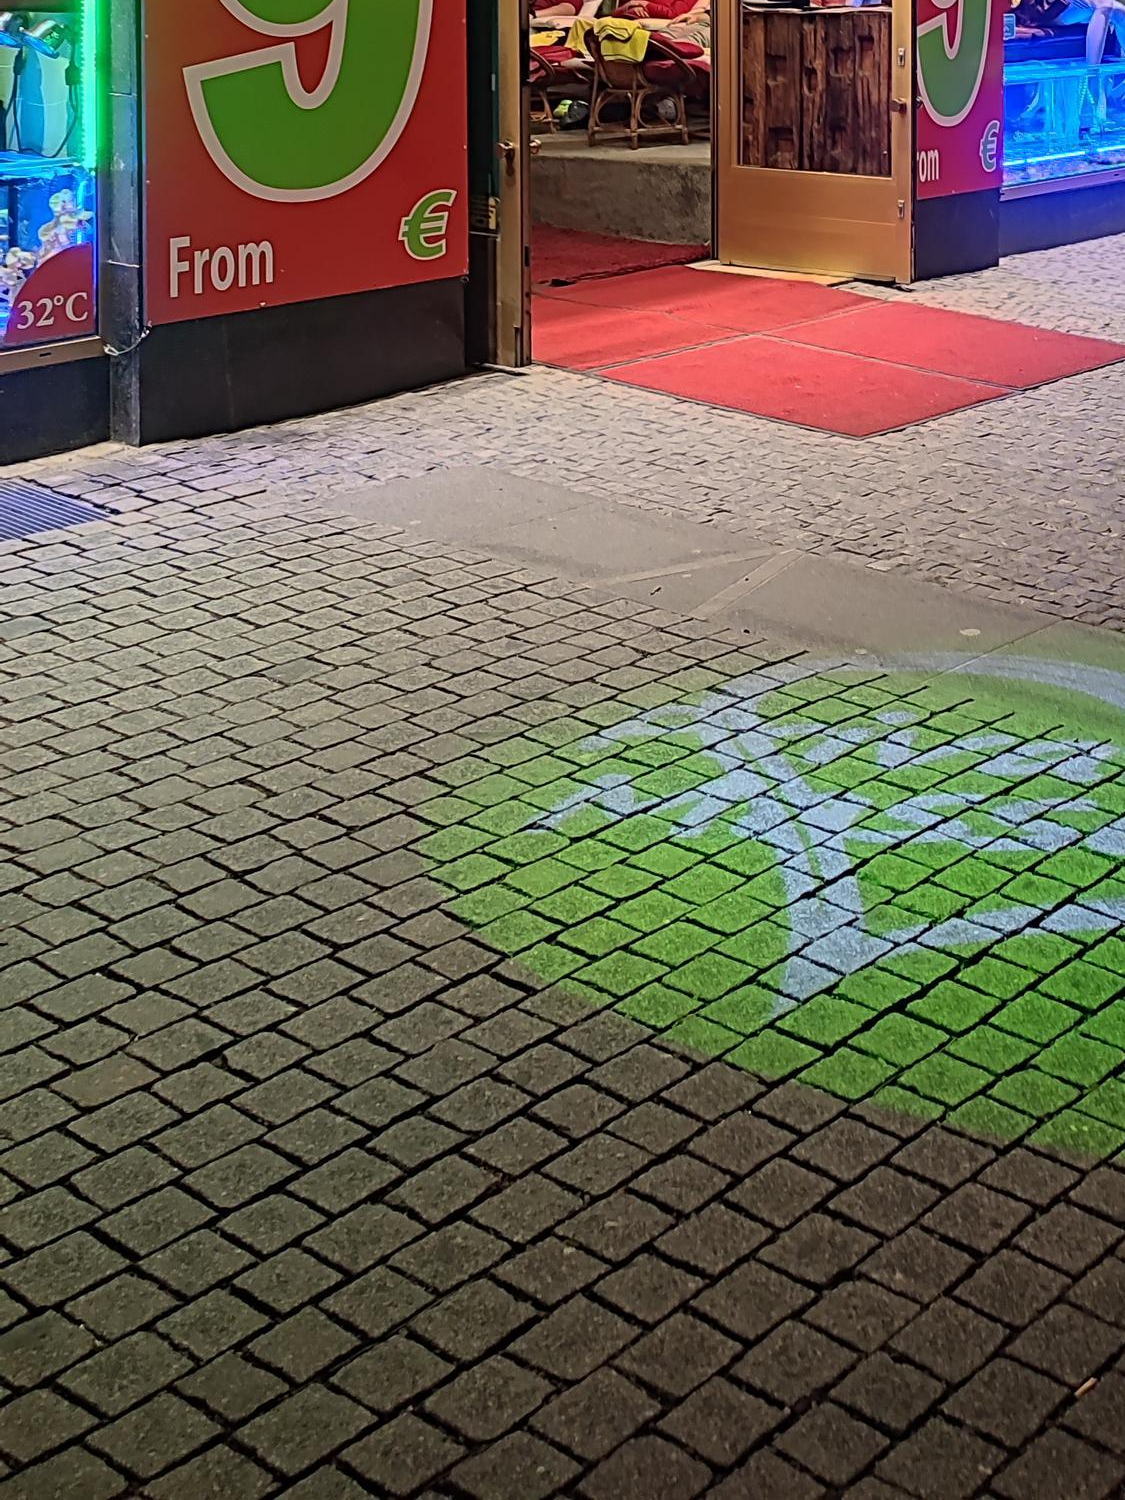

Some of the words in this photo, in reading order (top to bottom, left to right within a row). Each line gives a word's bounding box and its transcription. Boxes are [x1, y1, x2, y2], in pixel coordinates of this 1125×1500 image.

[917, 149, 940, 183] om
[169, 236, 275, 298] From
[17, 292, 89, 330] 32°C
